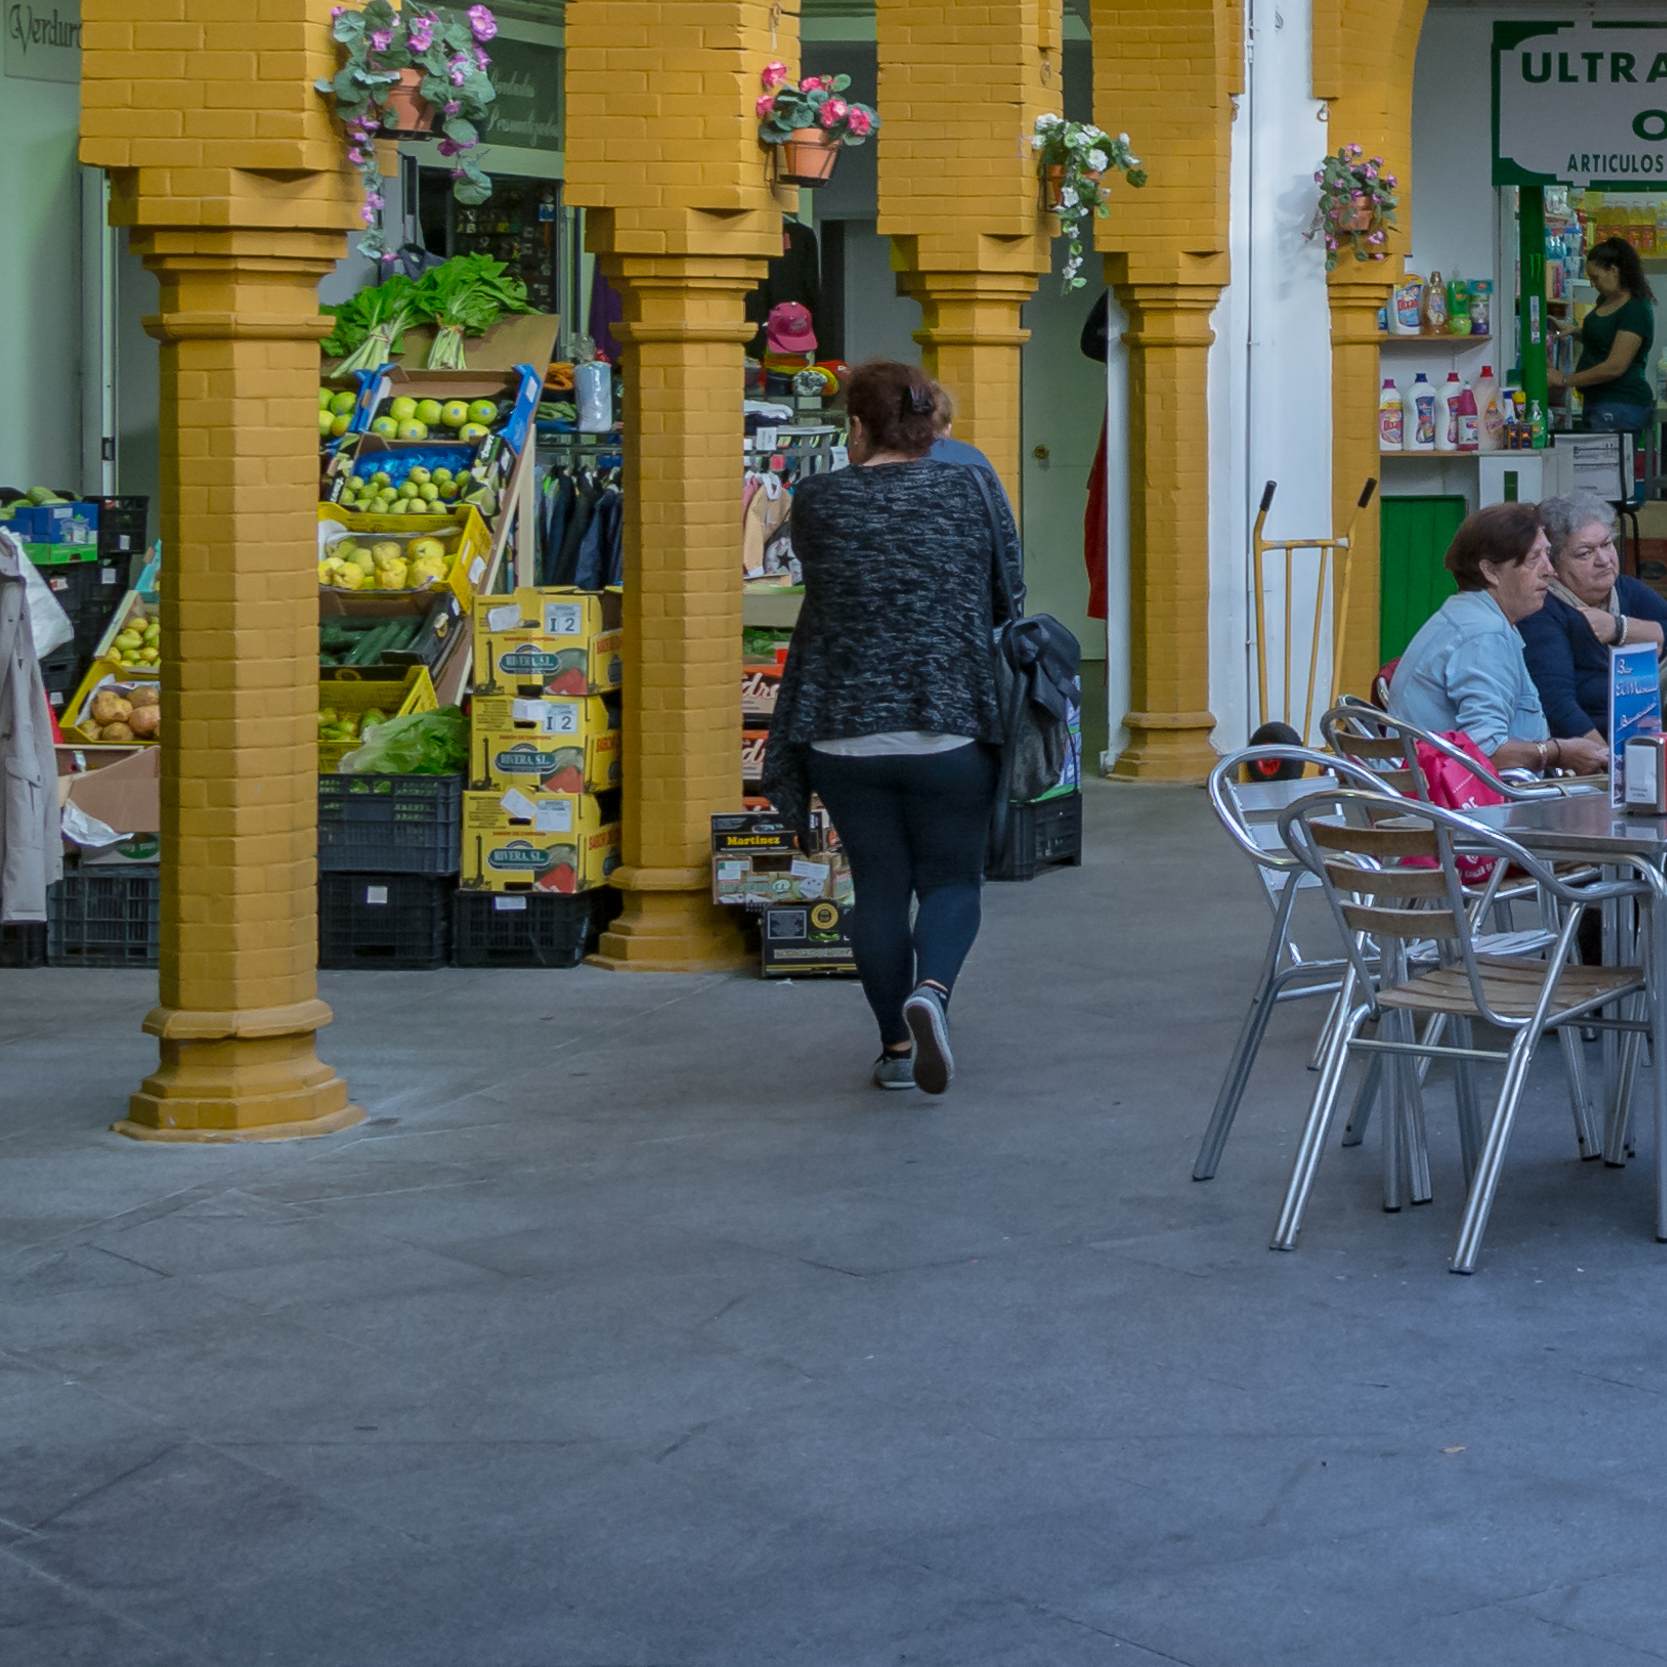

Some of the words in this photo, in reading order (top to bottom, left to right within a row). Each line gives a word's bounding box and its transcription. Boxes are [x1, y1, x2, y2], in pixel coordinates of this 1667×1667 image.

[1566, 154, 1665, 174] ARTICULOS
[565, 617, 575, 632] 2
[561, 716, 572, 730] 2
[727, 836, 781, 846] Martinez
